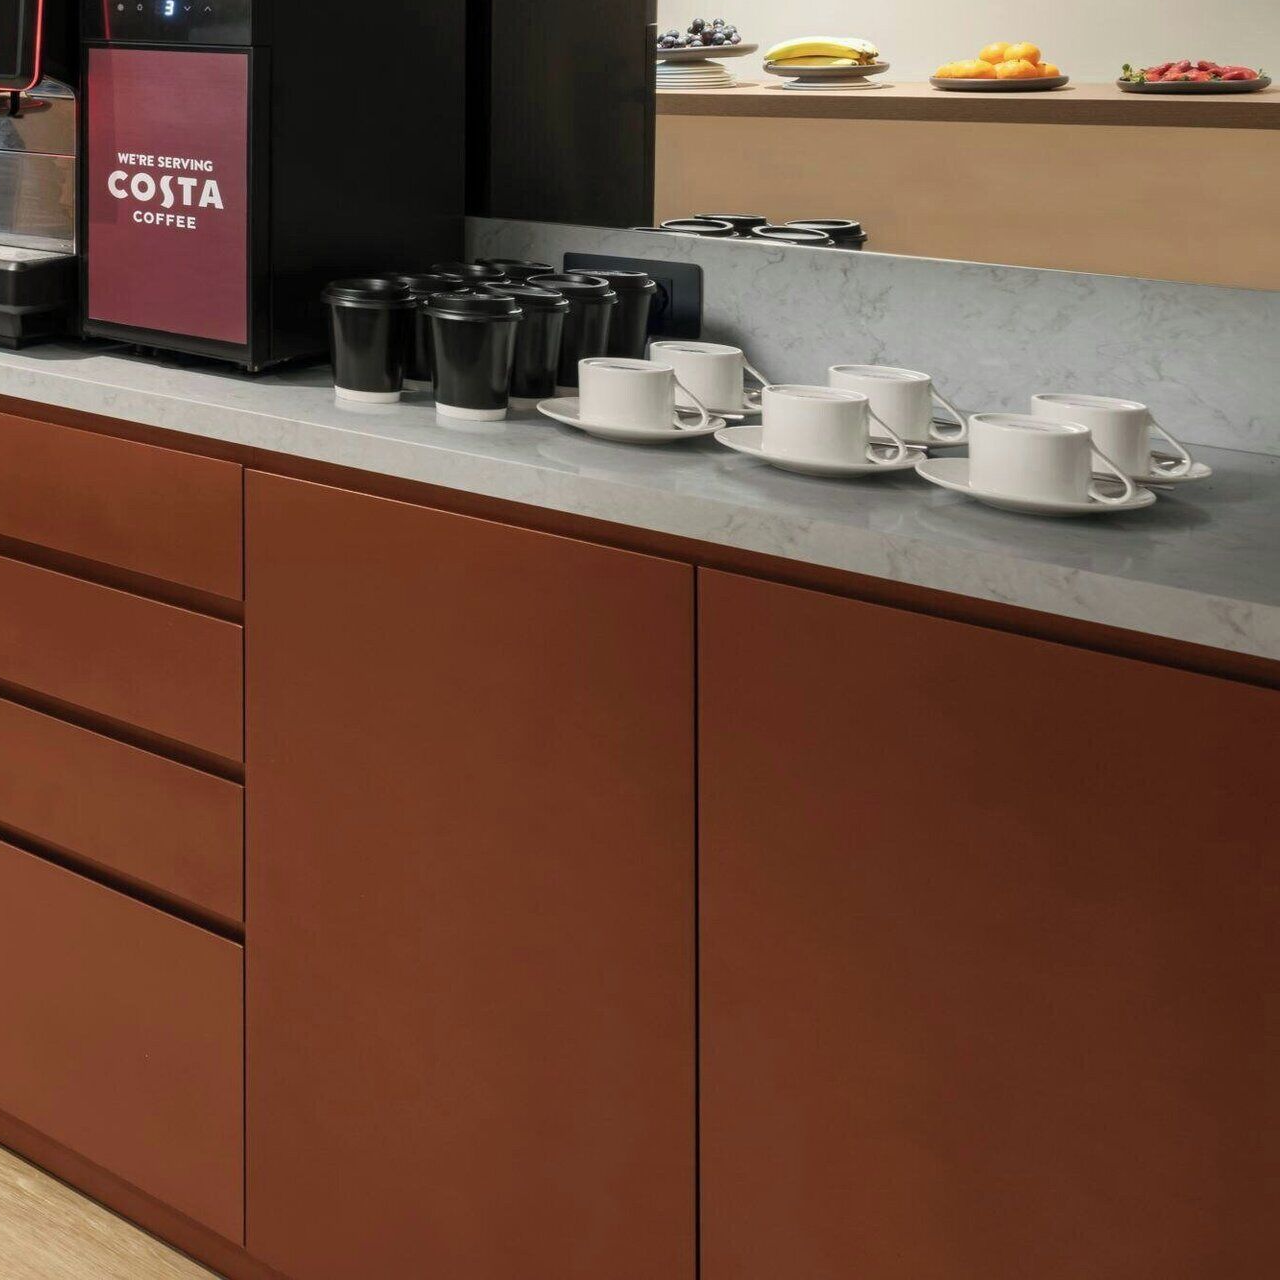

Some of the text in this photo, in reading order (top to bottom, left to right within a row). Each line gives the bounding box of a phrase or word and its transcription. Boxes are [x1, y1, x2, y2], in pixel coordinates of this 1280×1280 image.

[164, 0, 175, 17] 3
[118, 152, 214, 172] WE'RE SERVING
[107, 170, 225, 210] COSTA
[133, 210, 197, 230] COFFEE
